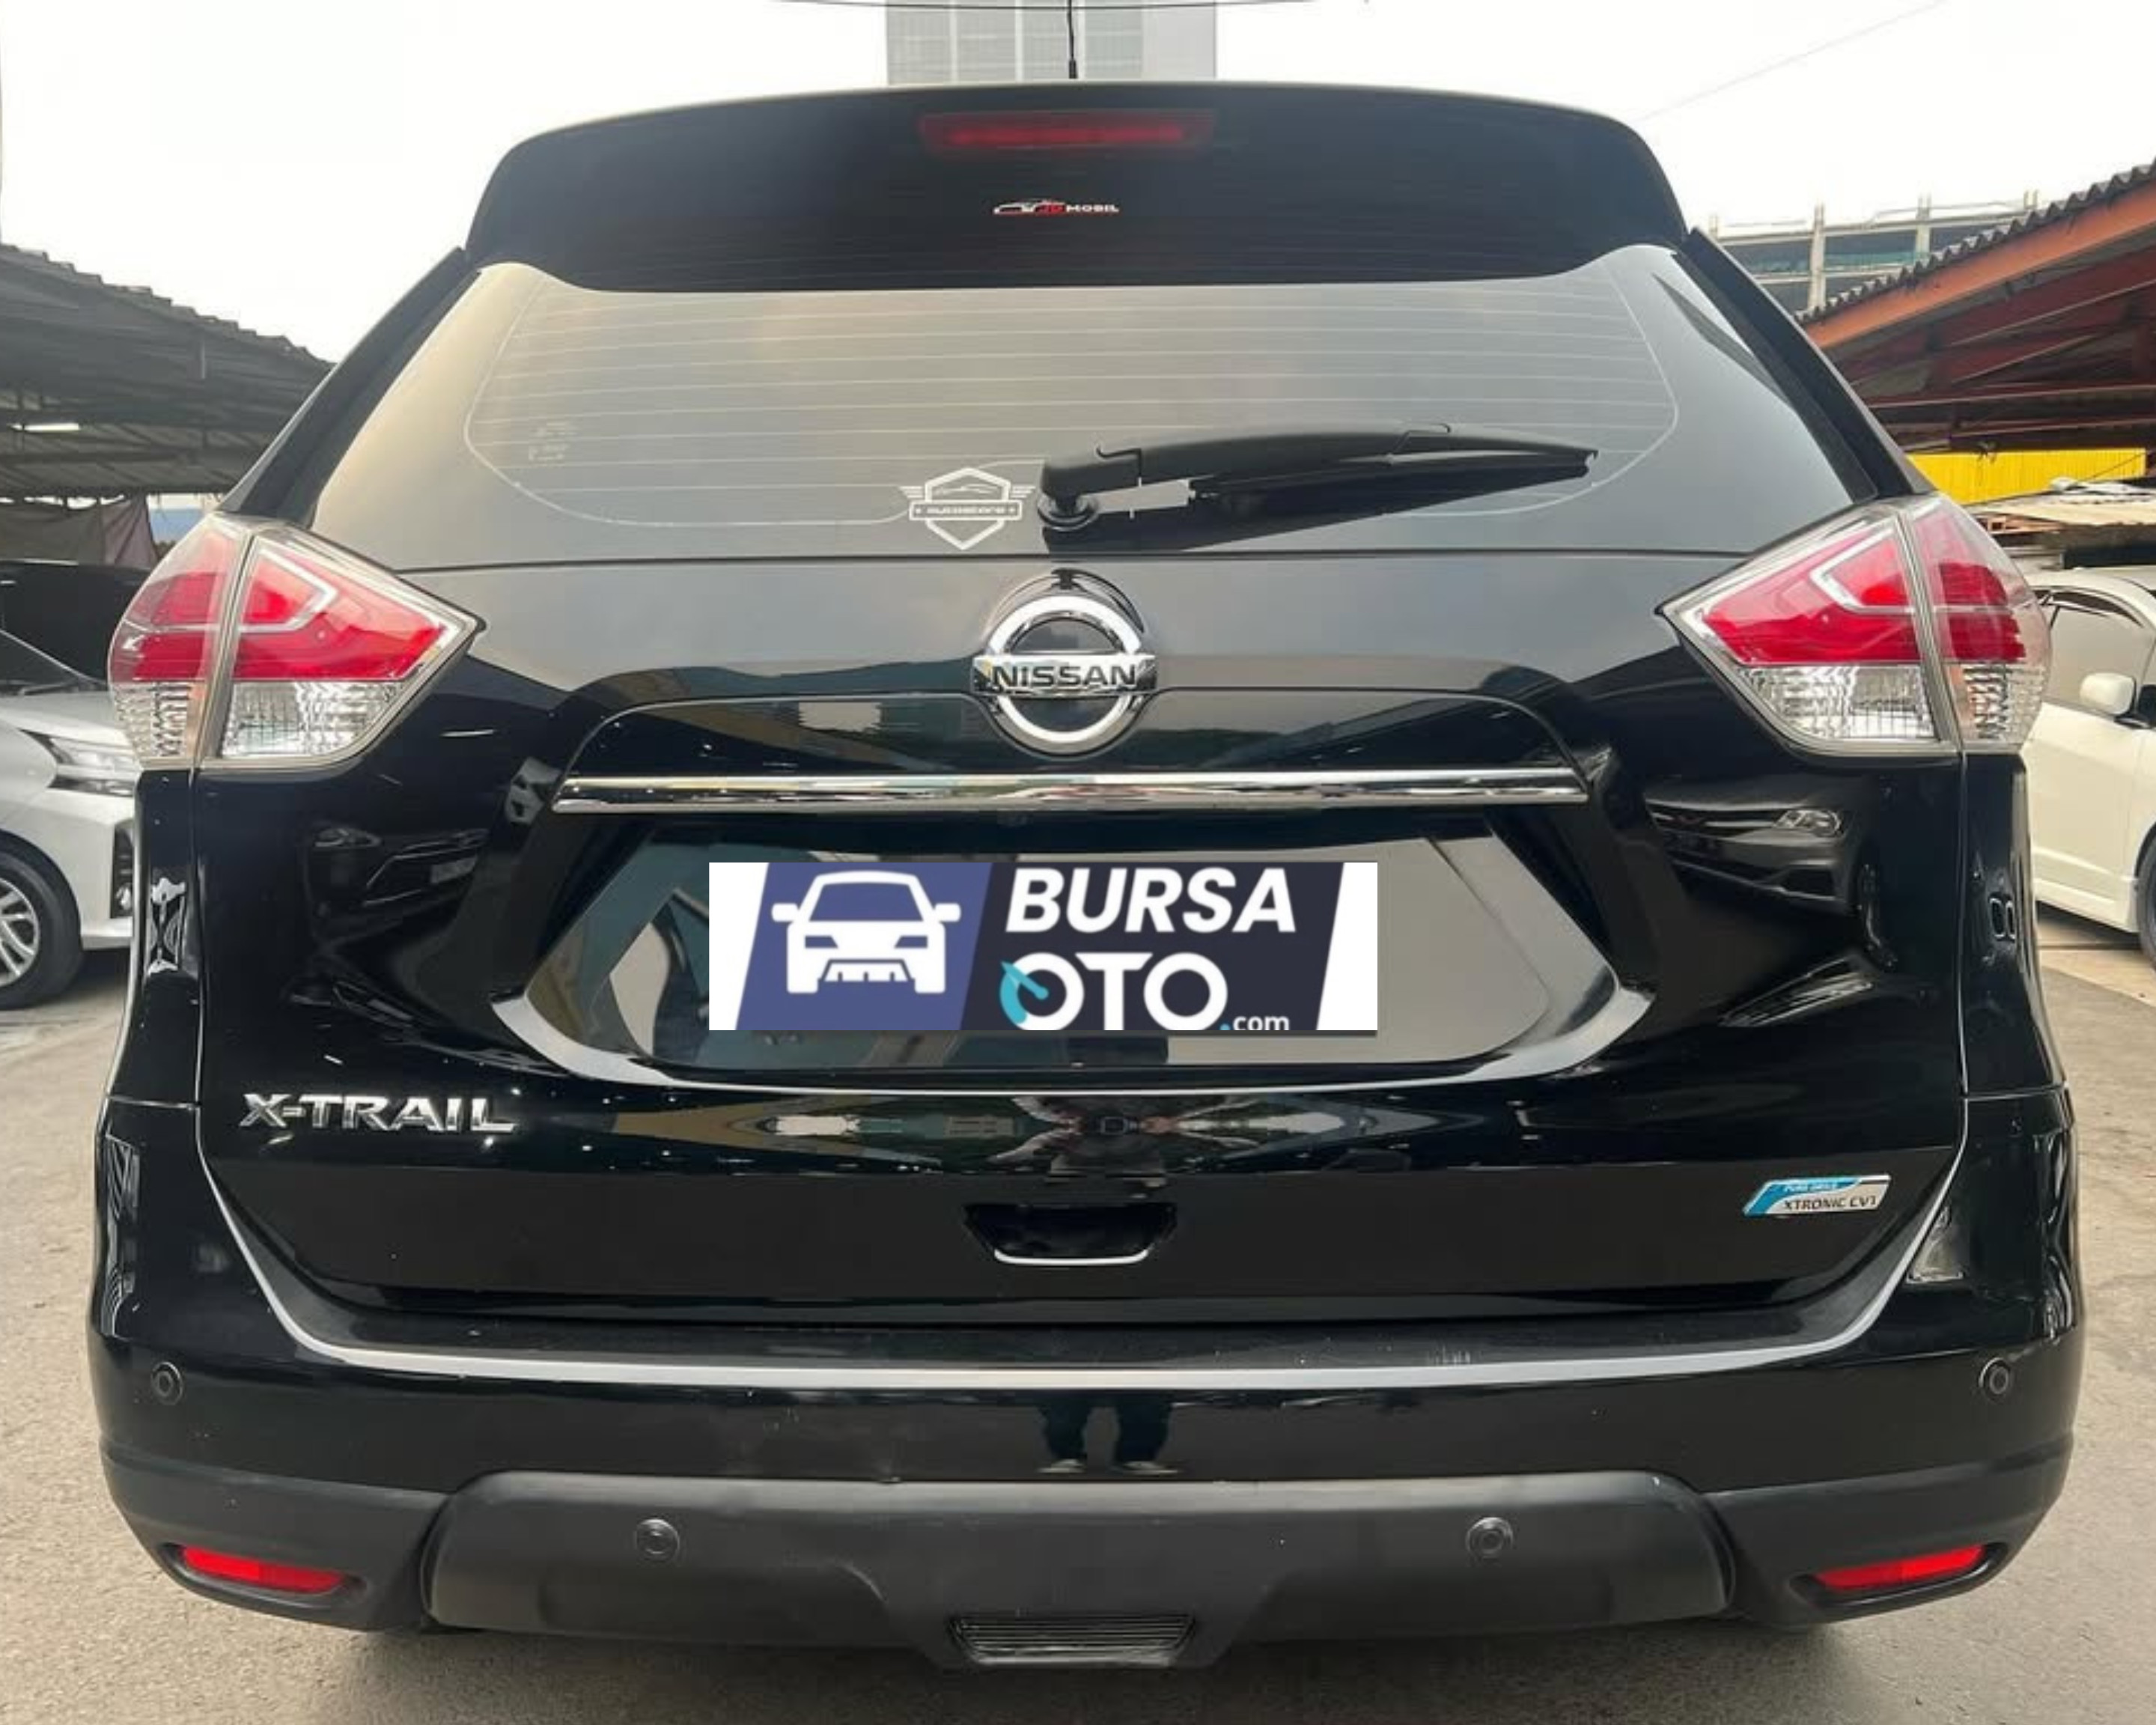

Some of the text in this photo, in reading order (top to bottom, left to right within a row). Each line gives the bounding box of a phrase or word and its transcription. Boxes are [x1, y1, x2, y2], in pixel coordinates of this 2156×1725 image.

[1066, 204, 1120, 213] MOBIL
[992, 665, 1136, 687] NISSAN
[239, 1093, 517, 1133] X-TRAIL
[1783, 1197, 1848, 1210] XTRONIC
